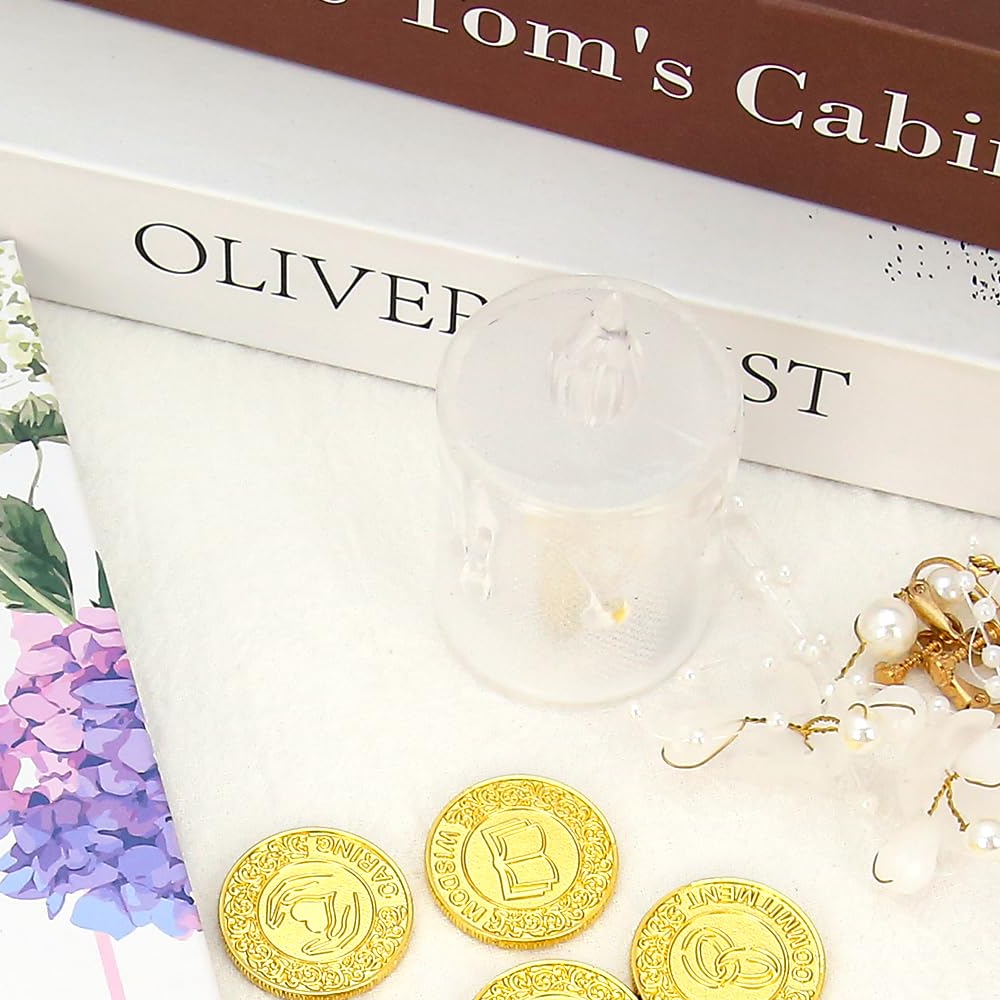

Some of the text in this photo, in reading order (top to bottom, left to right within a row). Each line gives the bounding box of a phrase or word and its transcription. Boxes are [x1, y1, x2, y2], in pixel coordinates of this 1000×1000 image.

[736, 64, 1000, 177] Cabi
[316, 834, 399, 899] CARING
[434, 829, 488, 923] WISDOM
[687, 886, 814, 983] COMMITMENT
